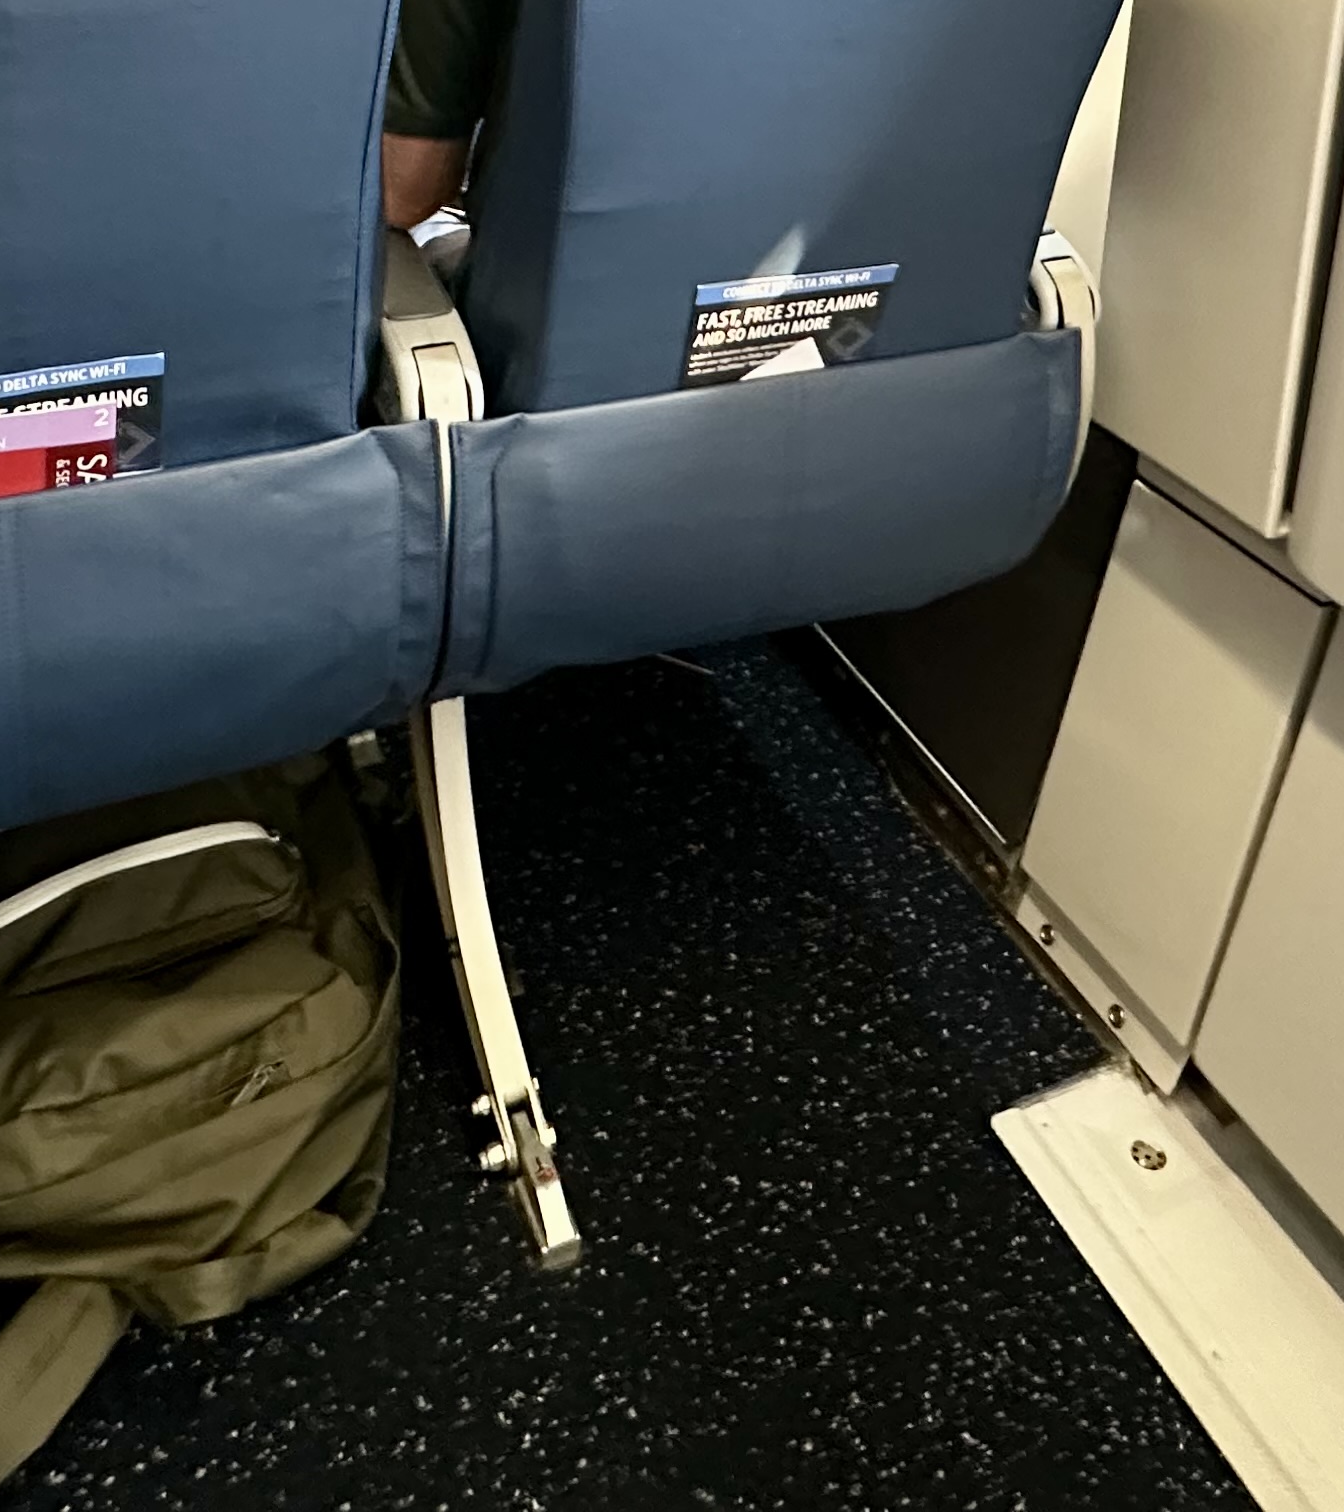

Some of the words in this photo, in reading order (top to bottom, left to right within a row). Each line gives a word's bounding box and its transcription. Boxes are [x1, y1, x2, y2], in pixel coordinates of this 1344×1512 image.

[722, 281, 770, 299] COCT
[818, 274, 844, 287] SYNC
[845, 271, 871, 285] WI-FI
[743, 304, 784, 325] FREE
[784, 291, 878, 318] STREAMING
[692, 331, 725, 348] AND
[726, 328, 746, 344] SO
[747, 321, 790, 340] MUCH
[791, 316, 831, 334] MORE
[3, 375, 48, 393] DELTA
[51, 367, 87, 385] SYNC
[90, 361, 126, 377] WI-FI
[94, 408, 110, 427] 2
